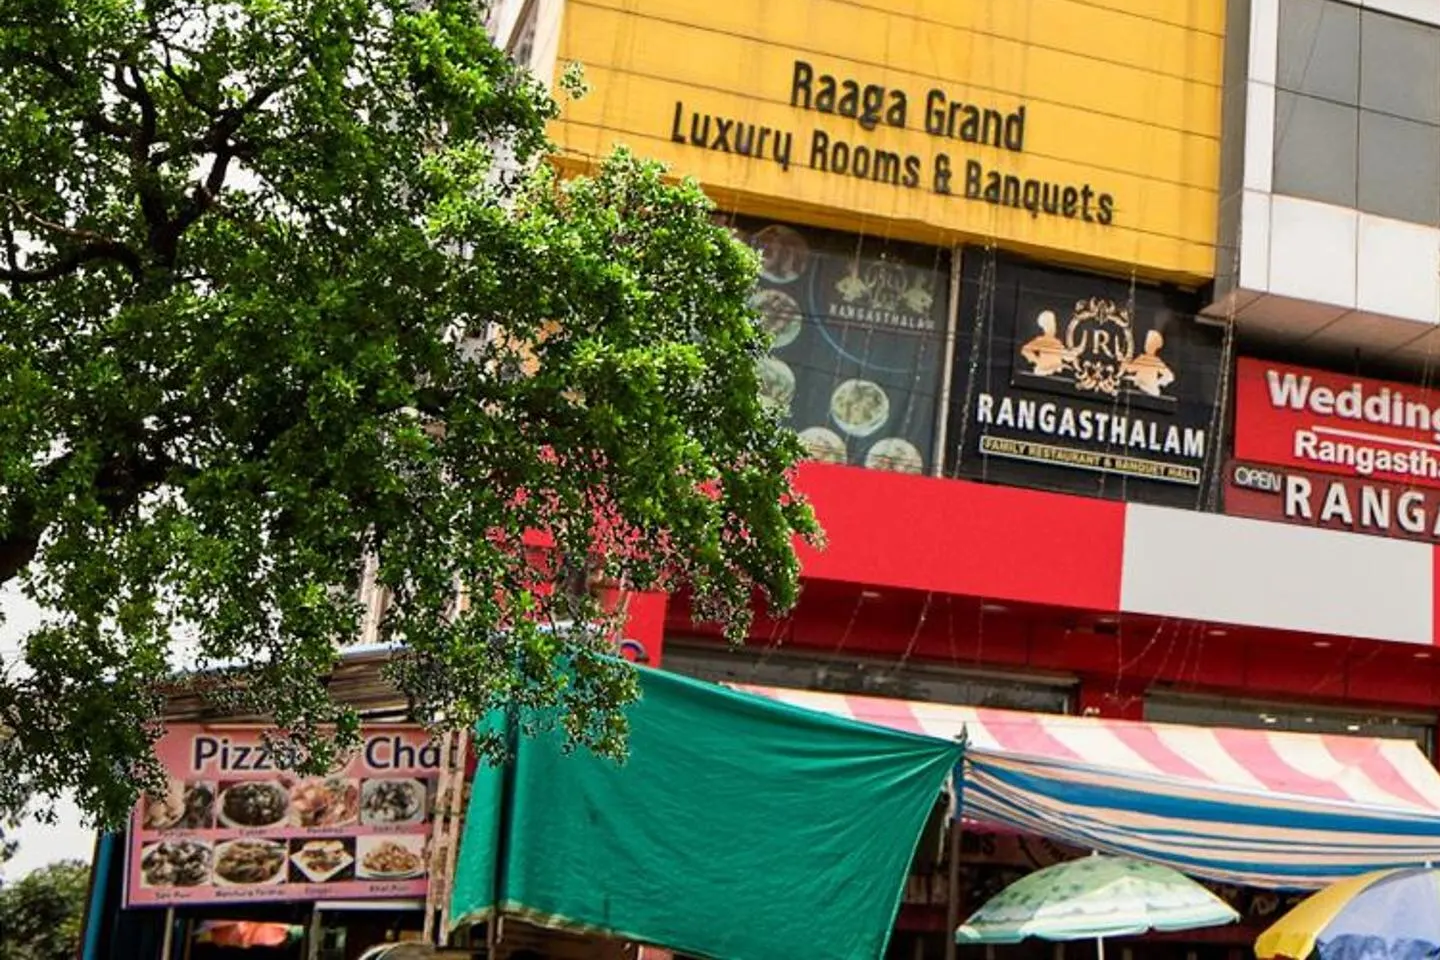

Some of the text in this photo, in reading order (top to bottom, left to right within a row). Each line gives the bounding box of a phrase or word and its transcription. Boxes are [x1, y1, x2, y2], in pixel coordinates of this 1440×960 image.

[789, 60, 1027, 153] Raaga Grand
[670, 101, 1115, 225] Luxury Rooms & Banquets
[977, 392, 1205, 459] RANGASTHALAM
[984, 438, 1027, 456] FAMILY
[1233, 466, 1281, 492] OPEN
